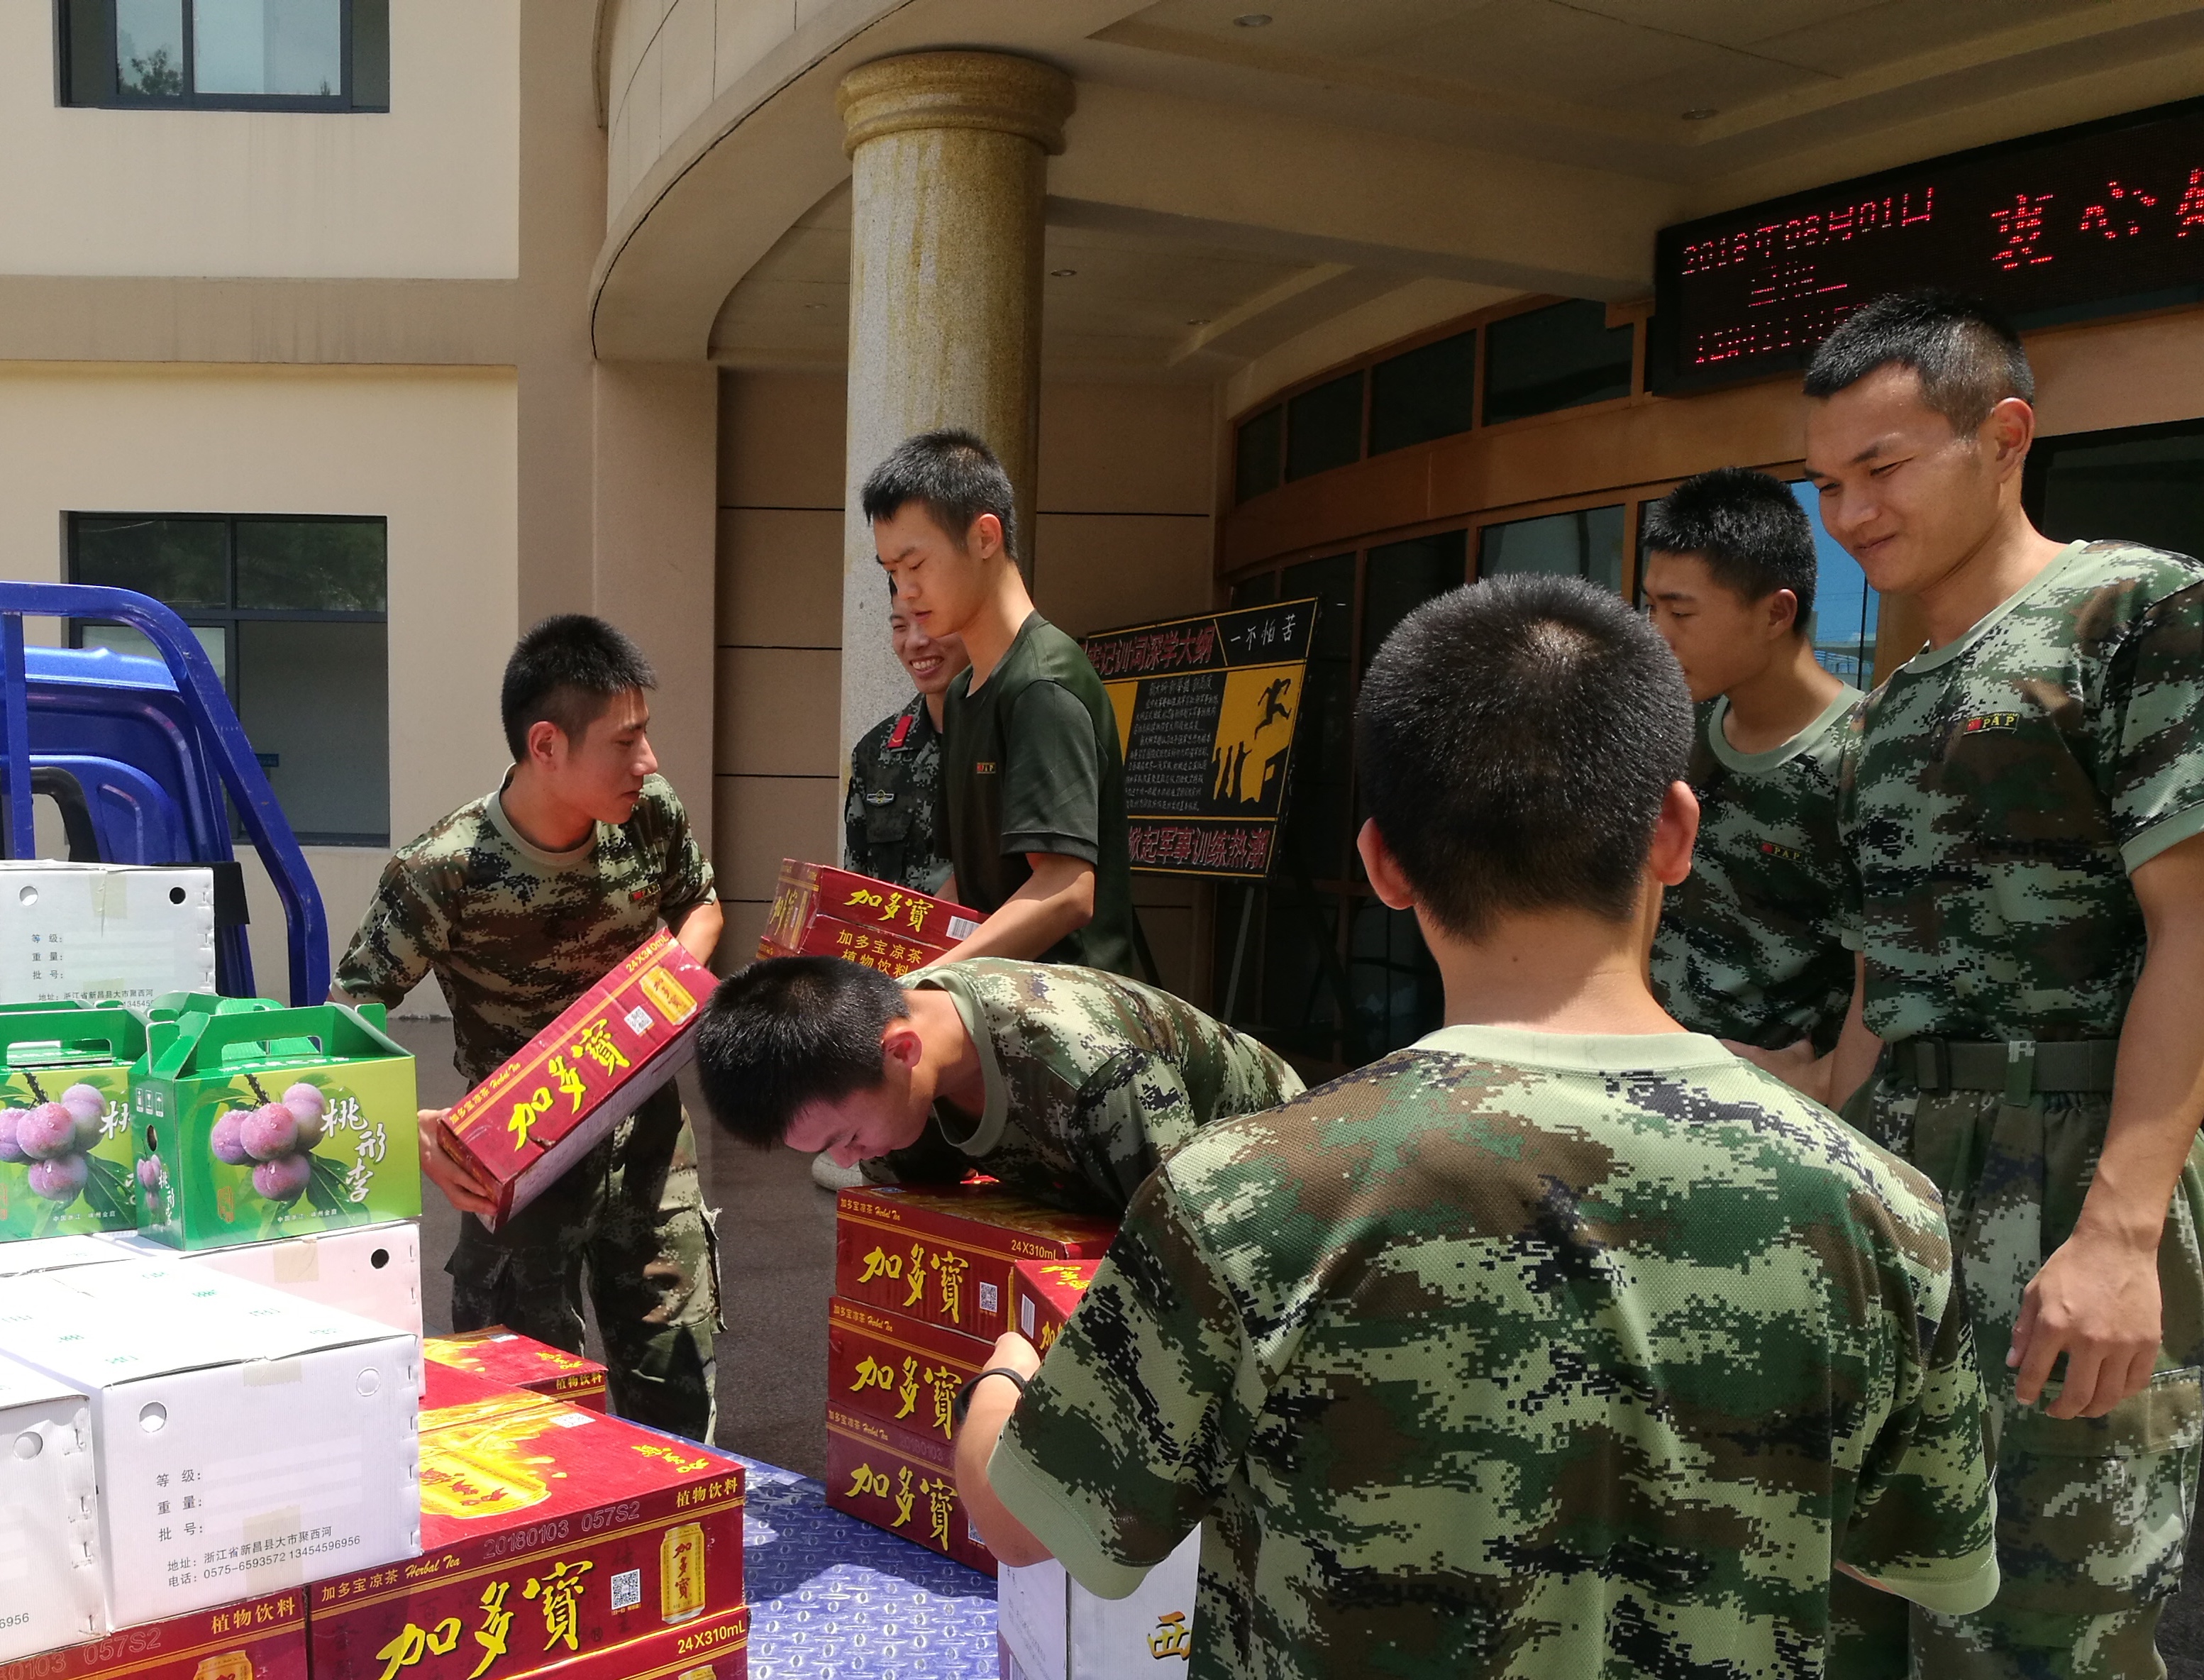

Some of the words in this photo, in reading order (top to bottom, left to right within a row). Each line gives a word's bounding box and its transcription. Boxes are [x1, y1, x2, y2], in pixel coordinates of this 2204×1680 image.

[1081, 624, 1216, 676] 牢记训词深学大纲
[1231, 614, 1296, 651] 一不怕苦
[1774, 846, 1800, 860] PAP
[837, 930, 923, 964] 加多宝凉茶
[320, 1096, 387, 1203] 桃形李
[1011, 1239, 1058, 1261] 24X310mL
[556, 1373, 602, 1391] 植物饮料
[676, 1477, 739, 1509] 植物饮料
[483, 1519, 570, 1559] 20180103
[581, 1501, 641, 1532] 057S2
[289, 1535, 361, 1562] 13454596956
[321, 1568, 399, 1603] 加多宝凉茶
[404, 1558, 440, 1580] Herbal
[443, 1554, 461, 1569] Tea
[211, 1596, 296, 1634] 植物饮料
[82, 1628, 162, 1666] 057S2
[677, 1620, 746, 1654] 24X310mL
